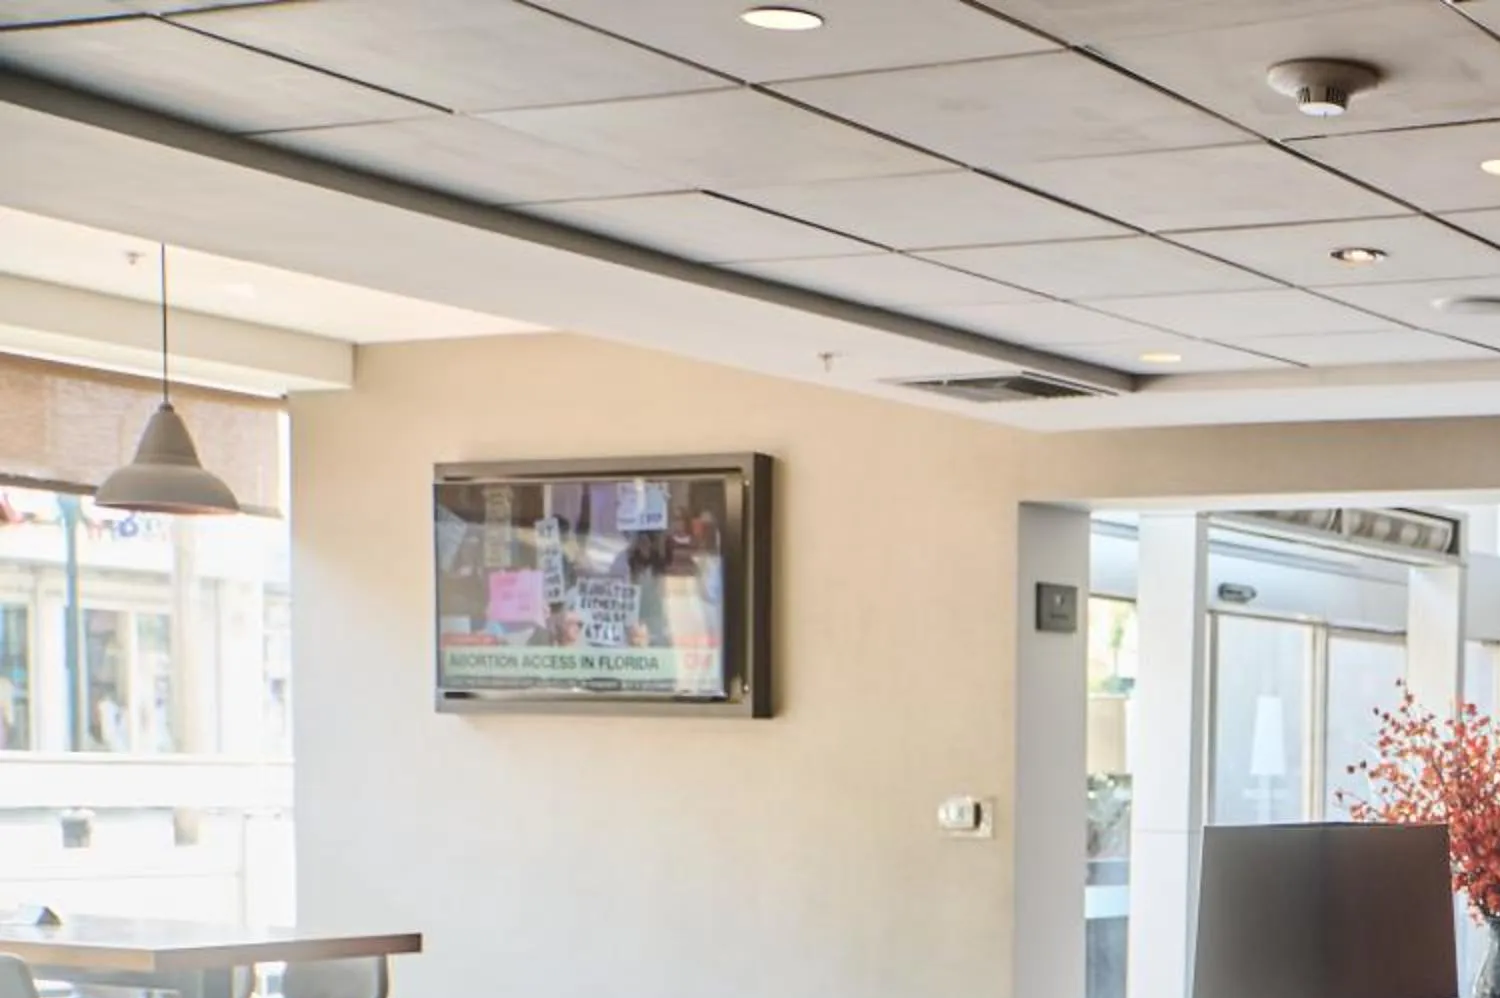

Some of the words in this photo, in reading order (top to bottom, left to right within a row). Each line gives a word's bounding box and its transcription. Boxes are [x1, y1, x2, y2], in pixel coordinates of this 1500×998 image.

[521, 655, 577, 670] ACCESS
[580, 655, 595, 670] IN
[599, 655, 659, 671] FLORIDA
